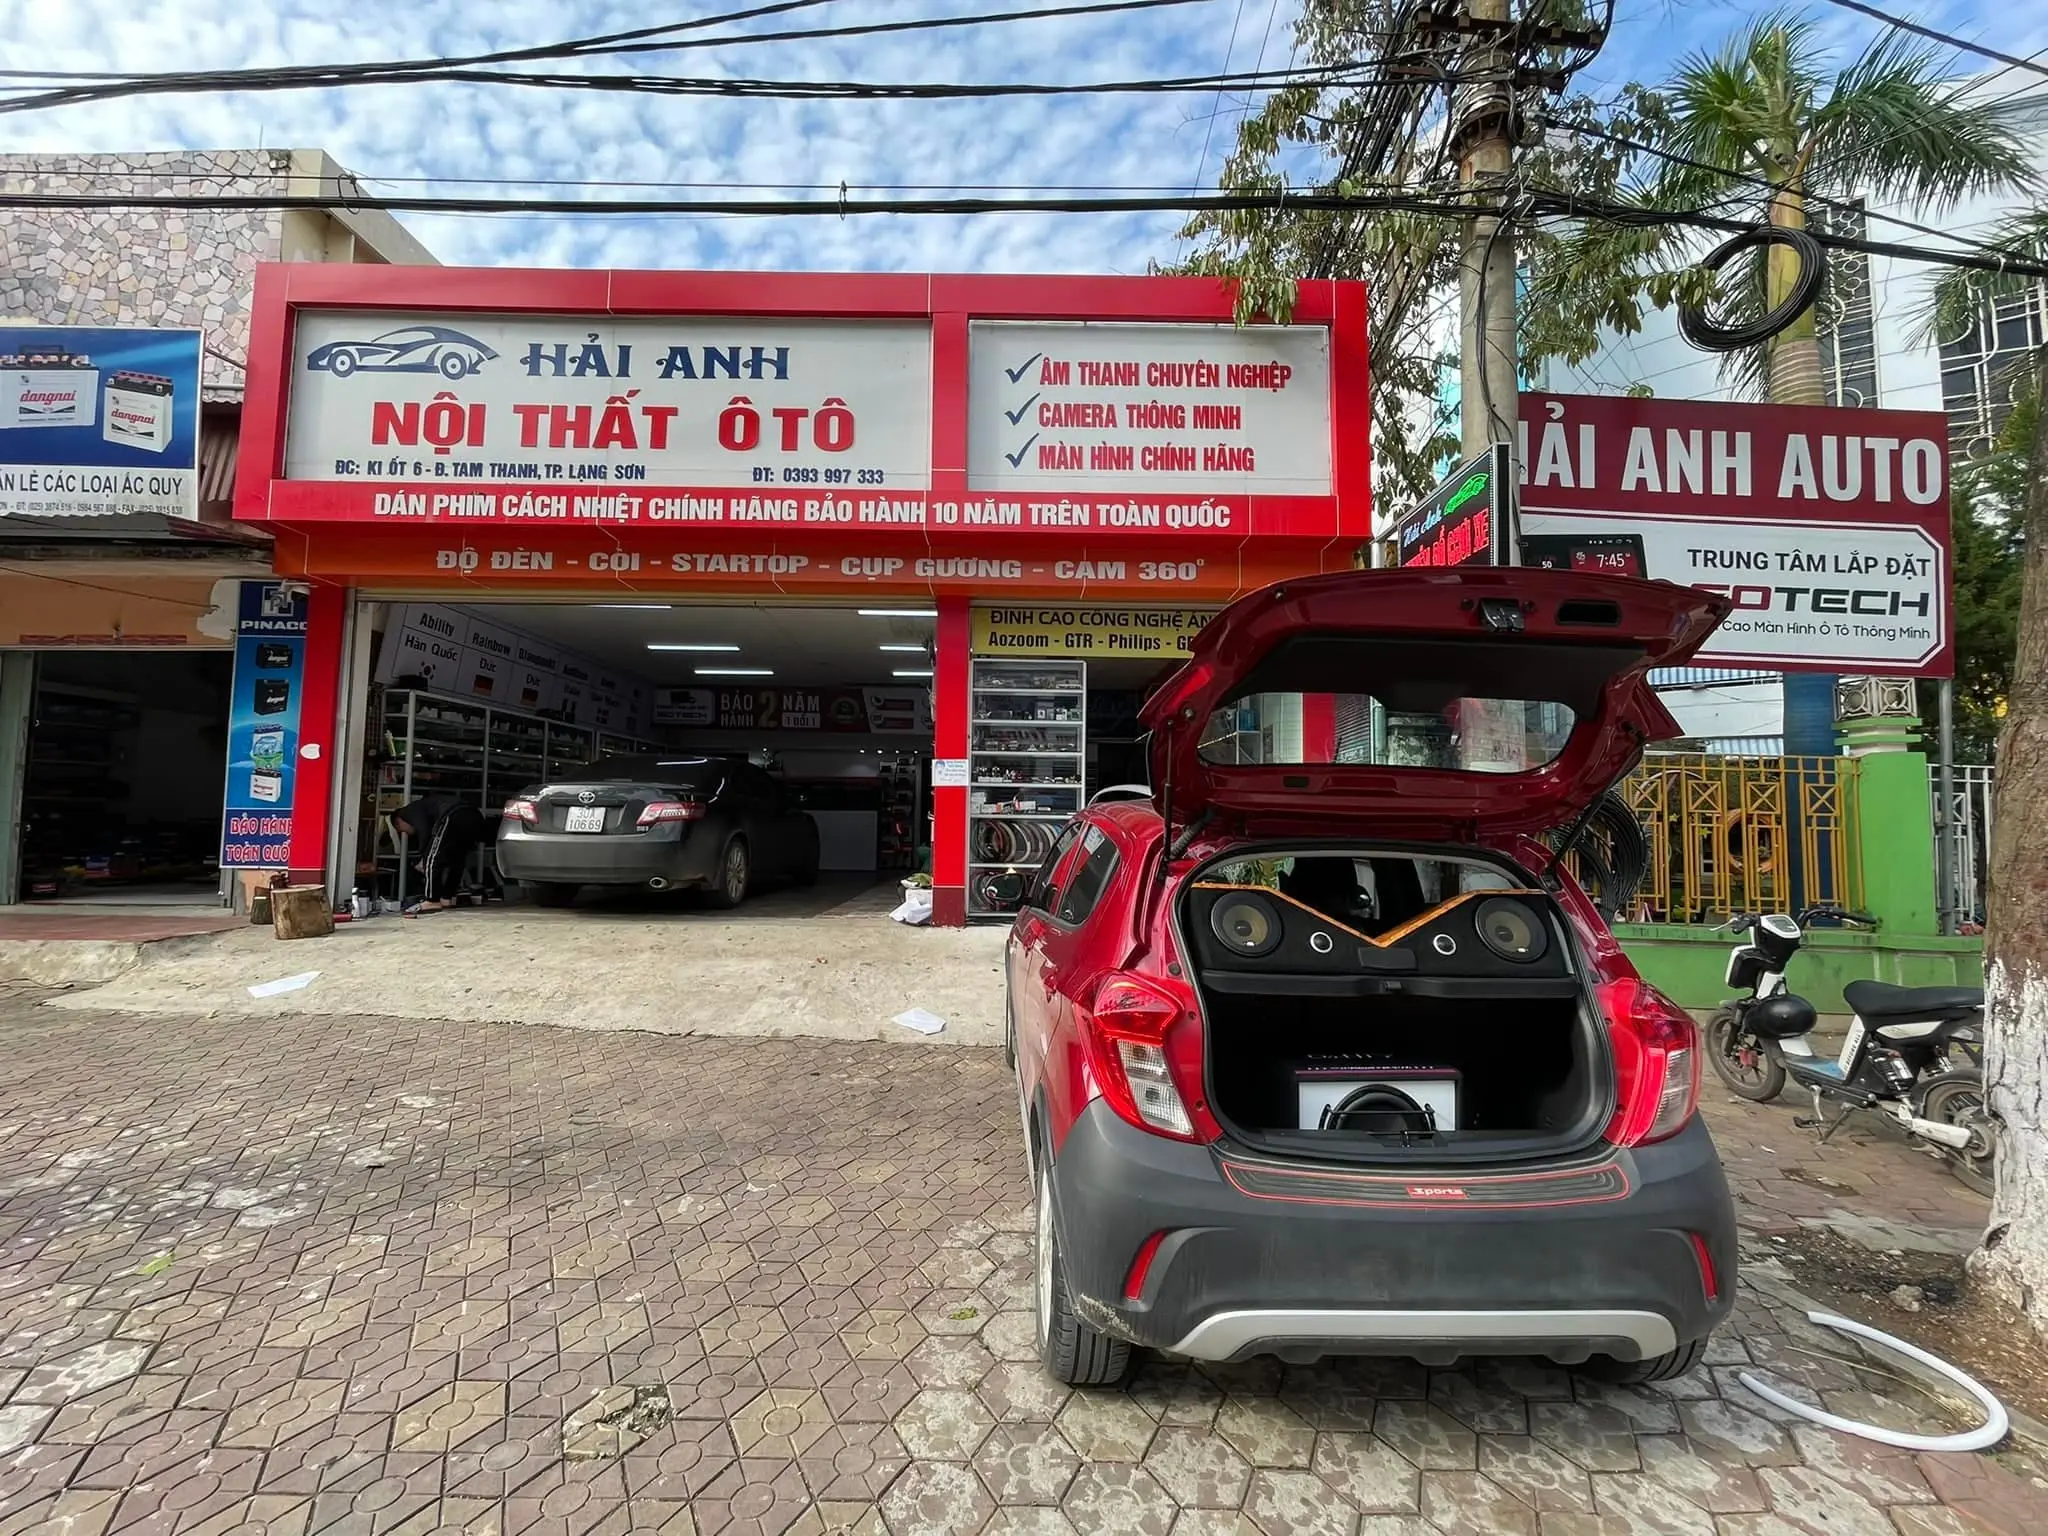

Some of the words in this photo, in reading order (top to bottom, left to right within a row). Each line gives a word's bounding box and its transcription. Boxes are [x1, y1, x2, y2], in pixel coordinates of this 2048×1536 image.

[519, 333, 632, 379] HẢI
[655, 345, 790, 380] ANH
[1039, 357, 1071, 386] ÂM
[1078, 361, 1140, 387] THANH
[1146, 359, 1220, 388] CHUYÊN
[1226, 360, 1292, 393] NGHIỆP
[371, 390, 487, 456] NỘI
[512, 388, 679, 450] THẤT
[718, 395, 761, 452] Ô
[772, 397, 855, 452] TÔ
[1038, 402, 1118, 429] CAMERA
[1126, 400, 1186, 430] THÔNG
[1192, 405, 1241, 430] MINH
[335, 459, 360, 476] ĐC:
[367, 460, 383, 476] KI
[389, 455, 407, 476] ỐT
[413, 461, 423, 476] 6
[434, 462, 449, 477] Đ.
[452, 462, 483, 478] TAM
[489, 462, 541, 481] THANH,
[544, 463, 564, 479] TP.
[568, 464, 608, 482] LẠNG
[614, 463, 645, 480] SƠN
[1038, 440, 1083, 470] MÀN
[1090, 440, 1134, 471] HÌNH
[1140, 441, 1197, 472] CHÍNH
[1202, 442, 1255, 472] HÃNG
[1620, 426, 1753, 497] ANH
[1776, 433, 1942, 505] AUTO
[43, 469, 76, 492] CÁC
[82, 475, 117, 498] LOẠI
[752, 466, 774, 483] ĐT:
[783, 467, 819, 484] 0393
[824, 468, 851, 484] 997
[857, 469, 884, 485] 333
[374, 489, 426, 516] DÁN
[432, 493, 496, 517] PHIM
[502, 490, 567, 518] CÁCH
[573, 492, 643, 523] NHIỆT
[648, 493, 724, 521] CHÍNH
[730, 494, 798, 522] HÃNG
[804, 492, 852, 523] BẢO
[859, 496, 925, 524] HÀNH
[932, 502, 959, 525] 10
[963, 497, 1022, 526] NĂM
[1028, 499, 1090, 527] TRÊN
[1096, 499, 1160, 527] TOÀN
[1165, 497, 1231, 529] QUỐC
[1473, 507, 1489, 553] XE
[436, 546, 479, 574] ĐỘ
[490, 547, 553, 570] ĐÈN
[671, 553, 809, 575] STARTOP
[840, 557, 904, 581] CỤP
[915, 556, 1023, 579] GƯƠNG
[1054, 560, 1126, 580] CAM
[1596, 553, 1625, 568] 7:45
[1687, 548, 1769, 570] TRUNG
[1775, 548, 1826, 572] TÂM
[1833, 550, 1878, 574] LẮP
[1884, 553, 1931, 580] ĐẶT
[1690, 583, 1930, 617] OTECH
[419, 612, 456, 638] Ability
[1038, 611, 1075, 626] CAO
[1079, 608, 1128, 627] CÔNG
[1134, 610, 1183, 632] NGHỆ
[1722, 620, 1751, 632] Cao
[1754, 619, 1784, 634] Màn
[1787, 621, 1817, 635] Hình
[1820, 621, 1831, 635] Ô
[1834, 623, 1850, 636] Tô
[1853, 625, 1896, 641] Thông
[1899, 626, 1931, 639] Minh
[404, 633, 427, 653] Hàn
[431, 641, 458, 663] Quốc
[989, 631, 1049, 648] Aozoom
[1065, 633, 1093, 649] GTR
[1109, 633, 1161, 652] Philips
[720, 690, 753, 711] BẢO
[757, 690, 779, 729] 2
[783, 691, 820, 712] NĂM
[720, 712, 754, 729] HÀNH
[230, 811, 259, 836] BẢO
[225, 841, 260, 863] TOÀN
